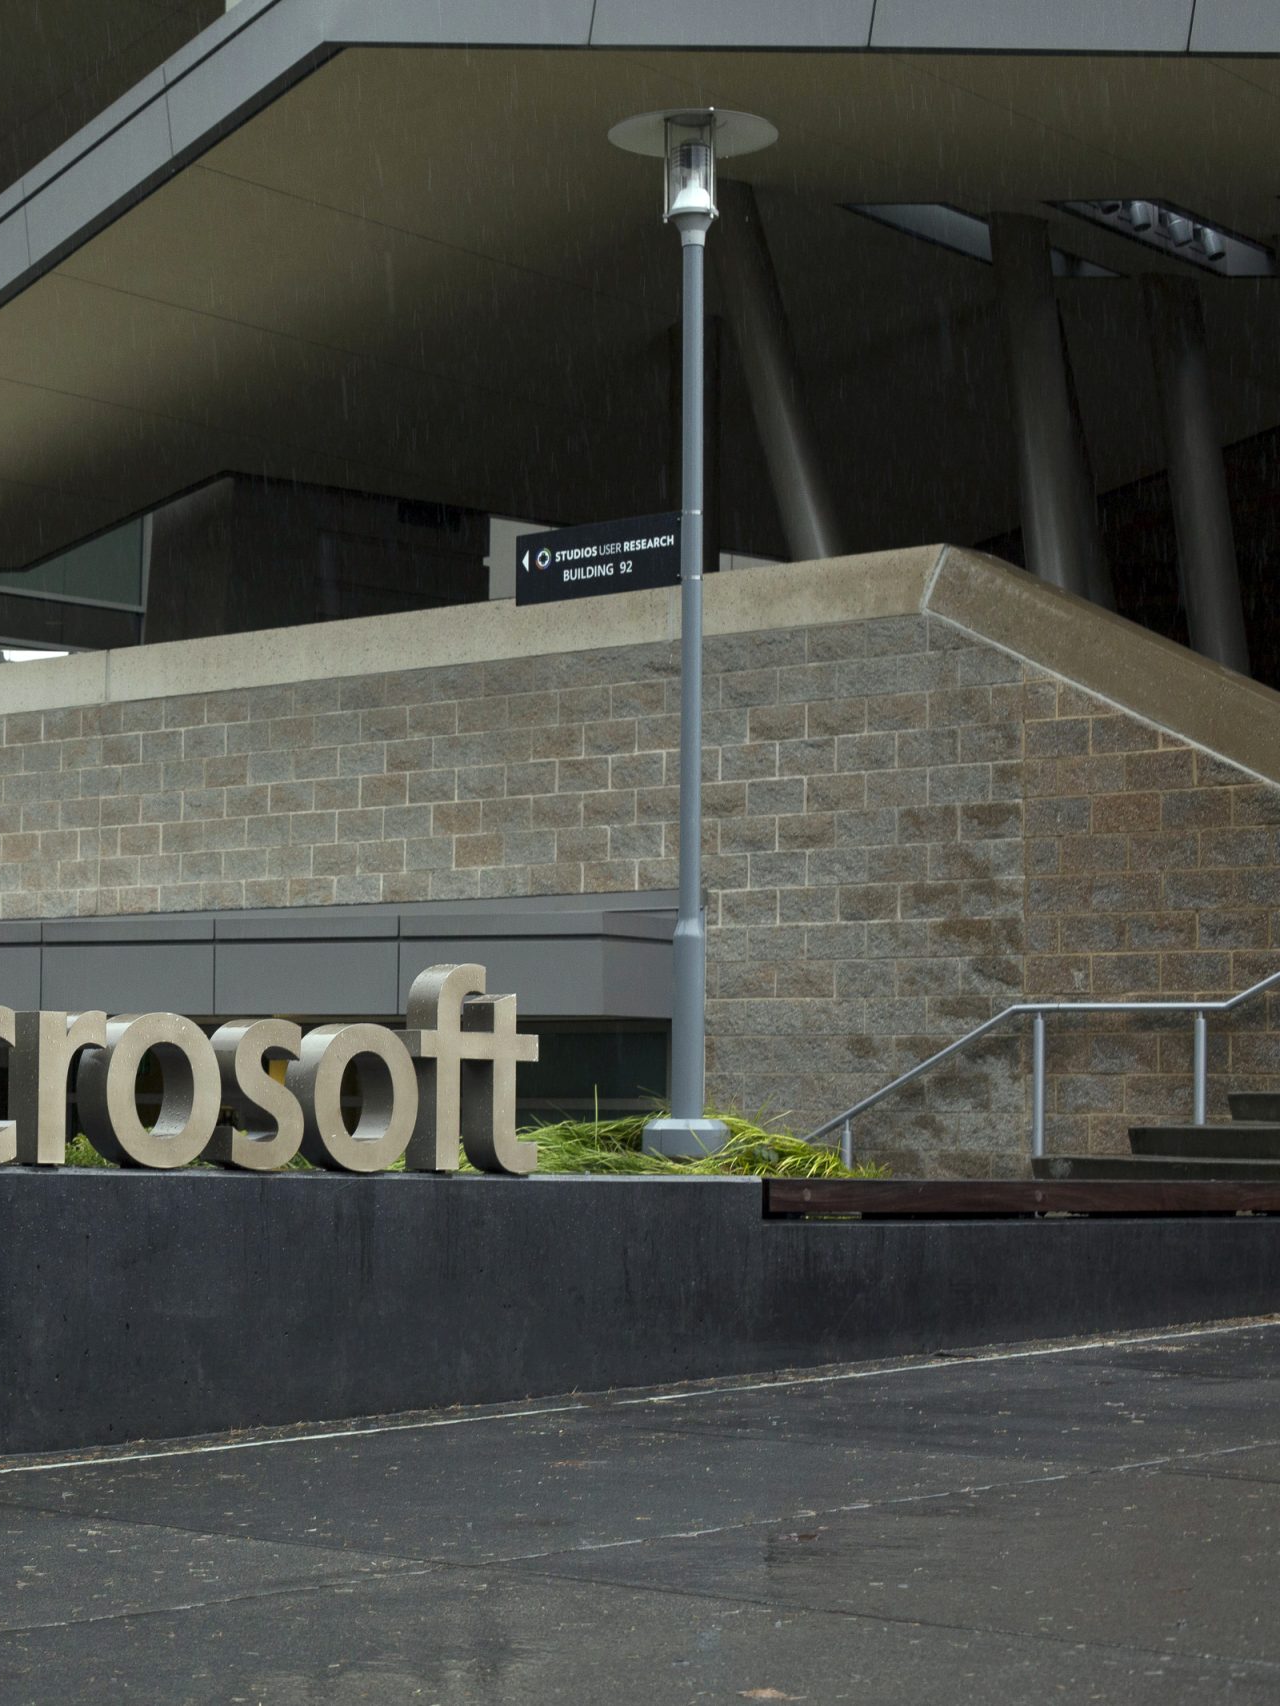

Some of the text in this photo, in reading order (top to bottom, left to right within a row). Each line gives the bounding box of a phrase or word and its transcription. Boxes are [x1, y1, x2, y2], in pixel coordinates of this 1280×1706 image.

[555, 534, 675, 563] STUDIOS USER RESEARCH
[563, 560, 633, 582] BUILDING 92
